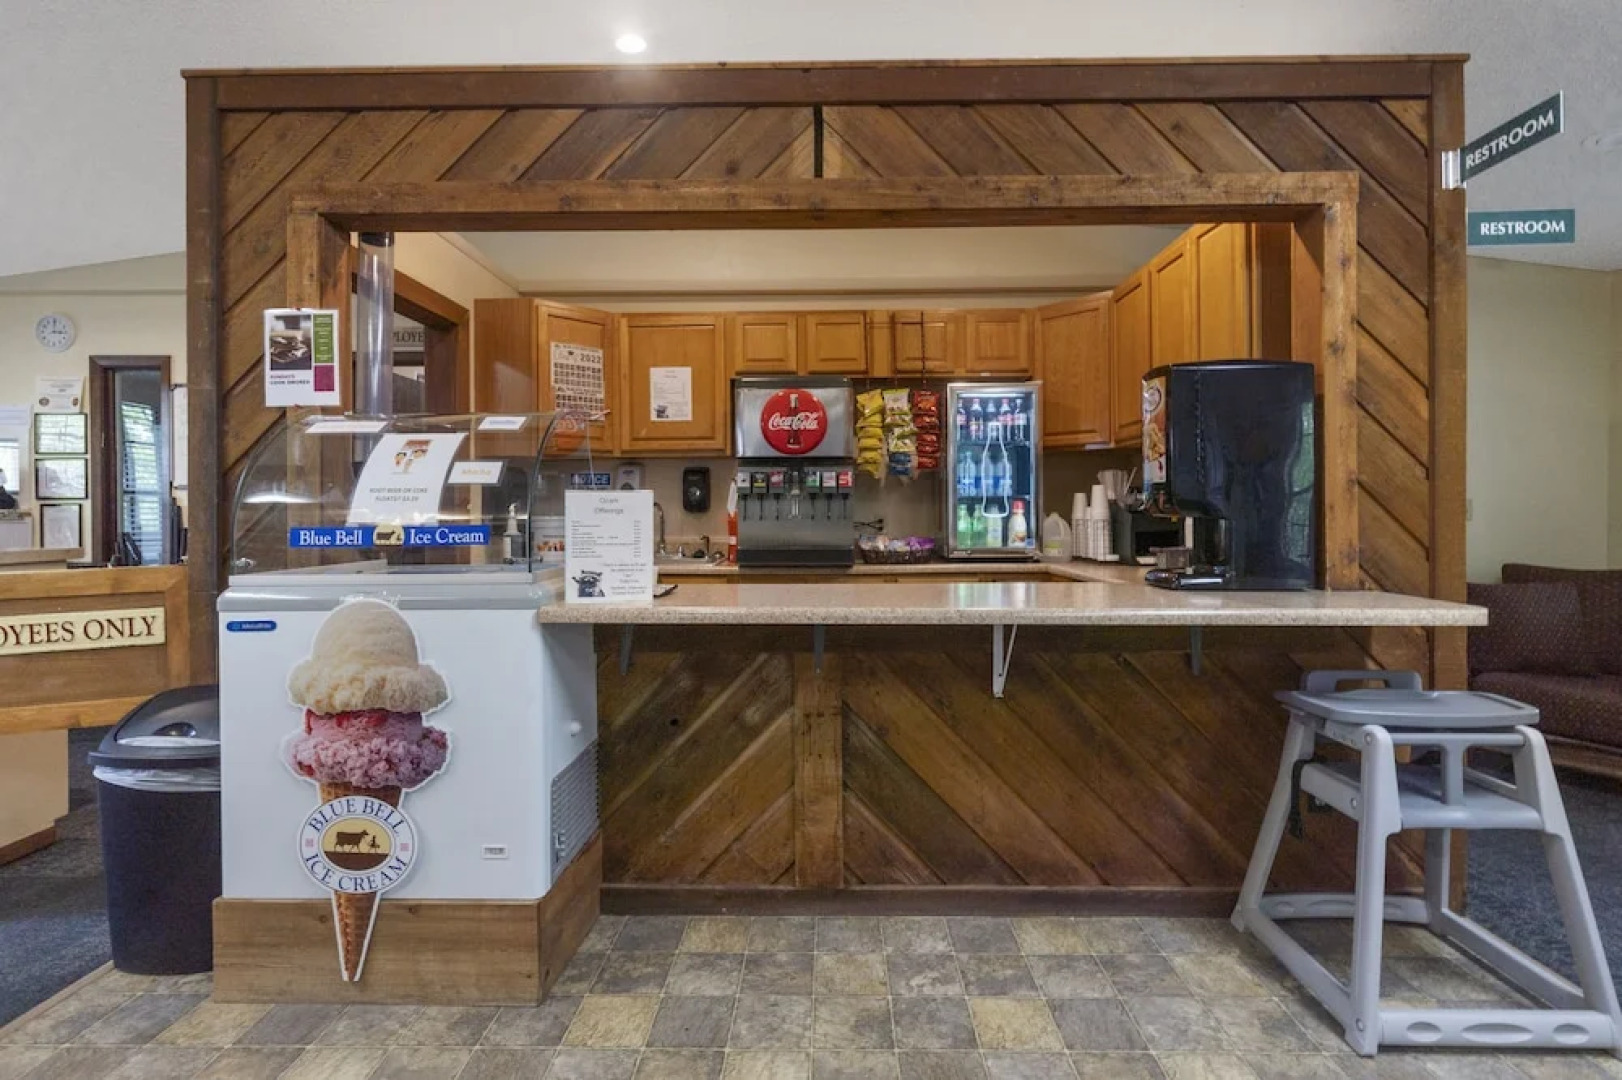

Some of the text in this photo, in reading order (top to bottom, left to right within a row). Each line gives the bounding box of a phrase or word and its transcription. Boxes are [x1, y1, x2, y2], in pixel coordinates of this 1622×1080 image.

[1465, 109, 1555, 170] RESTROOM
[1480, 219, 1566, 236] RESTROOM
[768, 412, 820, 430] Coca-Cola
[299, 528, 484, 546] Blue Bell Ice Cream
[83, 615, 157, 642] ONLY
[308, 798, 405, 835] BLUE BELL
[306, 853, 408, 892] ICE CREAM
